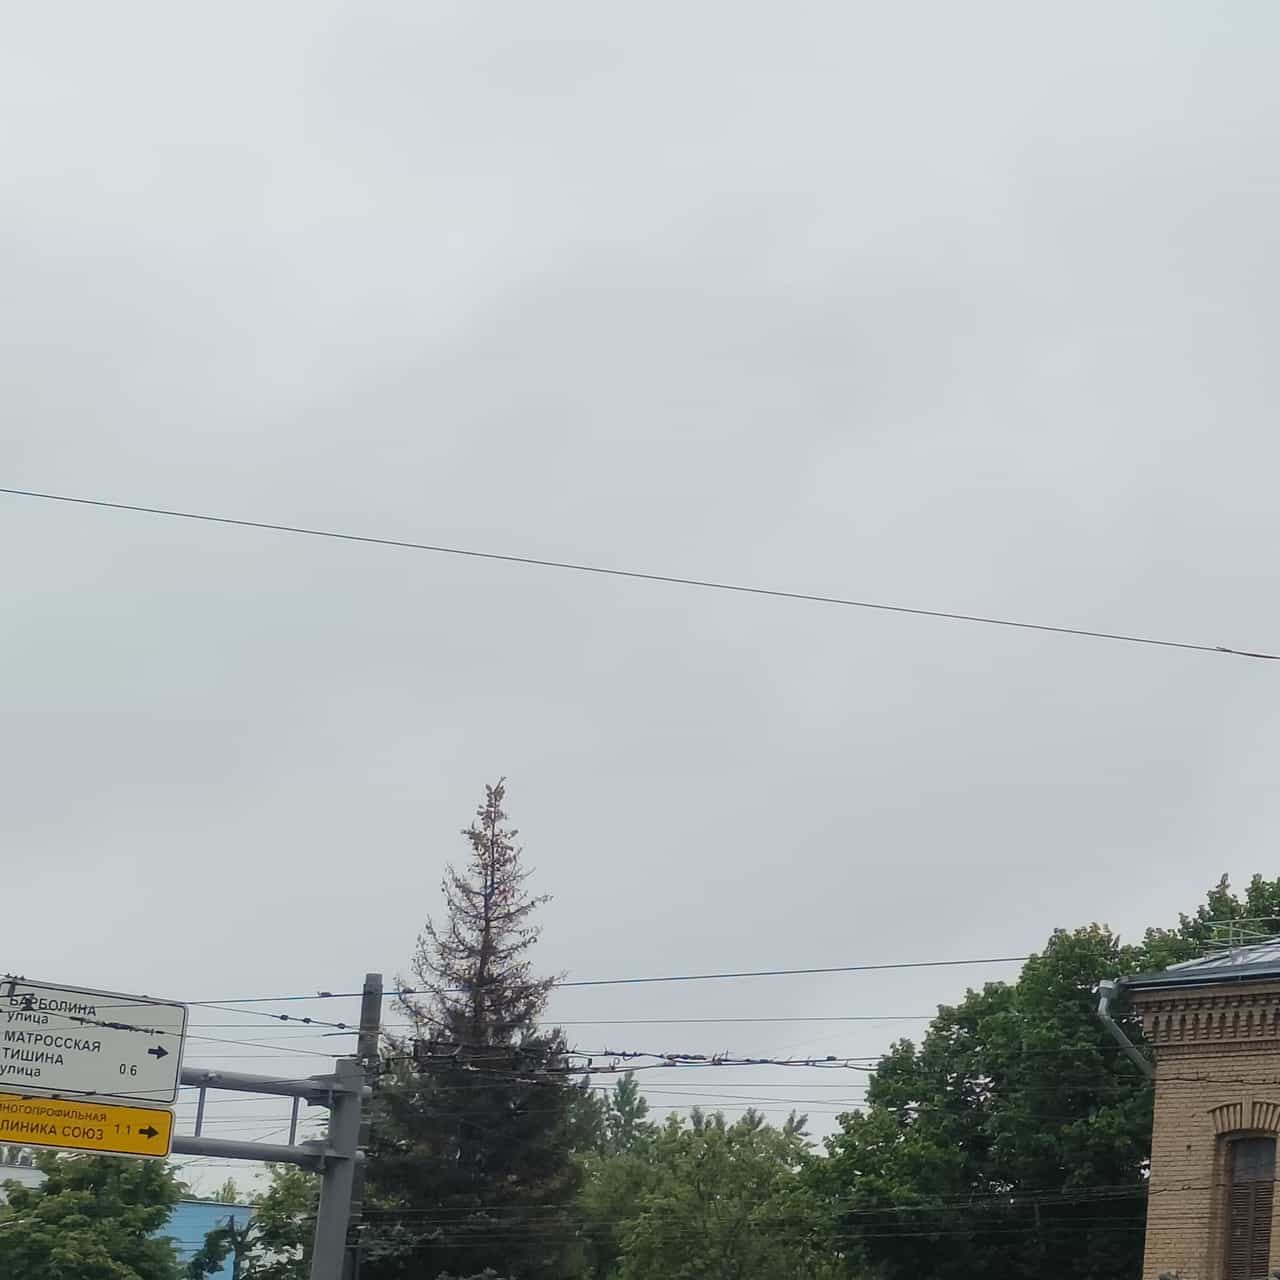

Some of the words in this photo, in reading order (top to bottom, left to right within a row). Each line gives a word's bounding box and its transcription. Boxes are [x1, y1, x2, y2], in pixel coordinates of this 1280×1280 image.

[8, 1012, 49, 1024] улица
[4, 1030, 102, 1052] МАТРОССКАЯ
[2, 1047, 64, 1065] ТИШИНА
[0, 1064, 41, 1078] улица
[0, 1119, 57, 1136] ЛИНИКА
[62, 1126, 104, 1140] СОЮЗ
